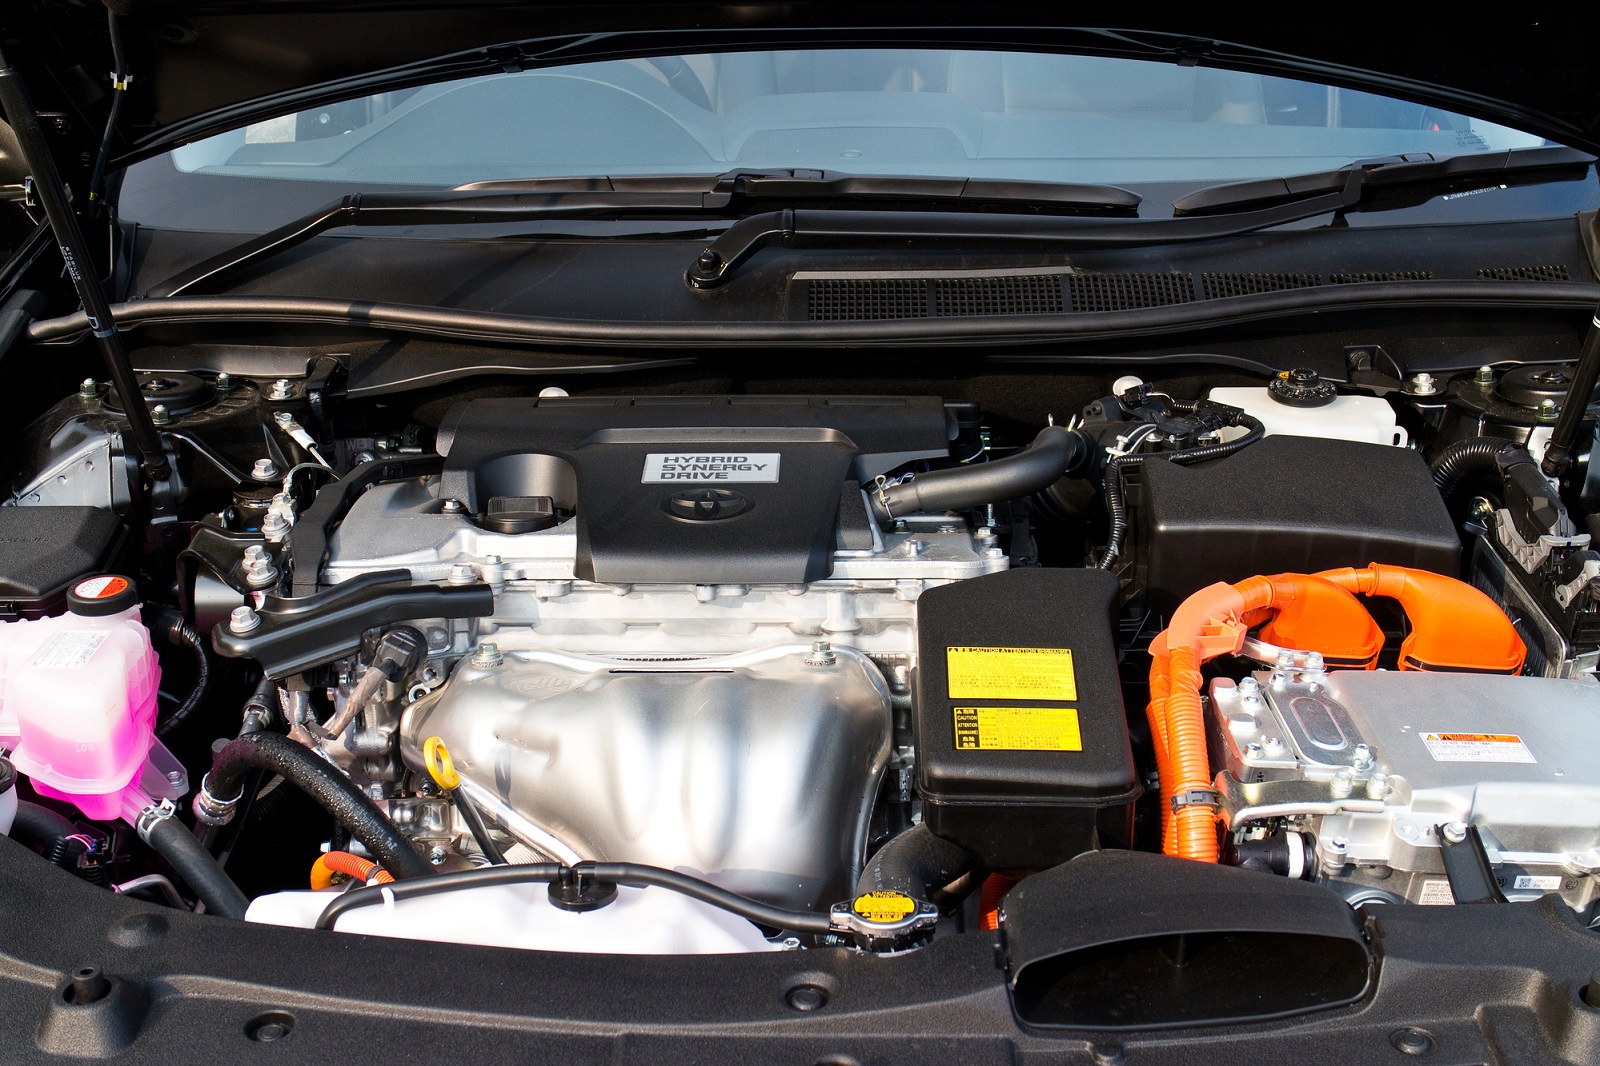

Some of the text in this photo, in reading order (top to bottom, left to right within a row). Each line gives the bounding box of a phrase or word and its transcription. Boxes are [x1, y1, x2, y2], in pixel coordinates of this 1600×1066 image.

[65, 246, 81, 280] STABILUS
[661, 463, 768, 471] SYNERGY
[660, 472, 729, 480] DRIVE
[75, 743, 96, 753] LOW
